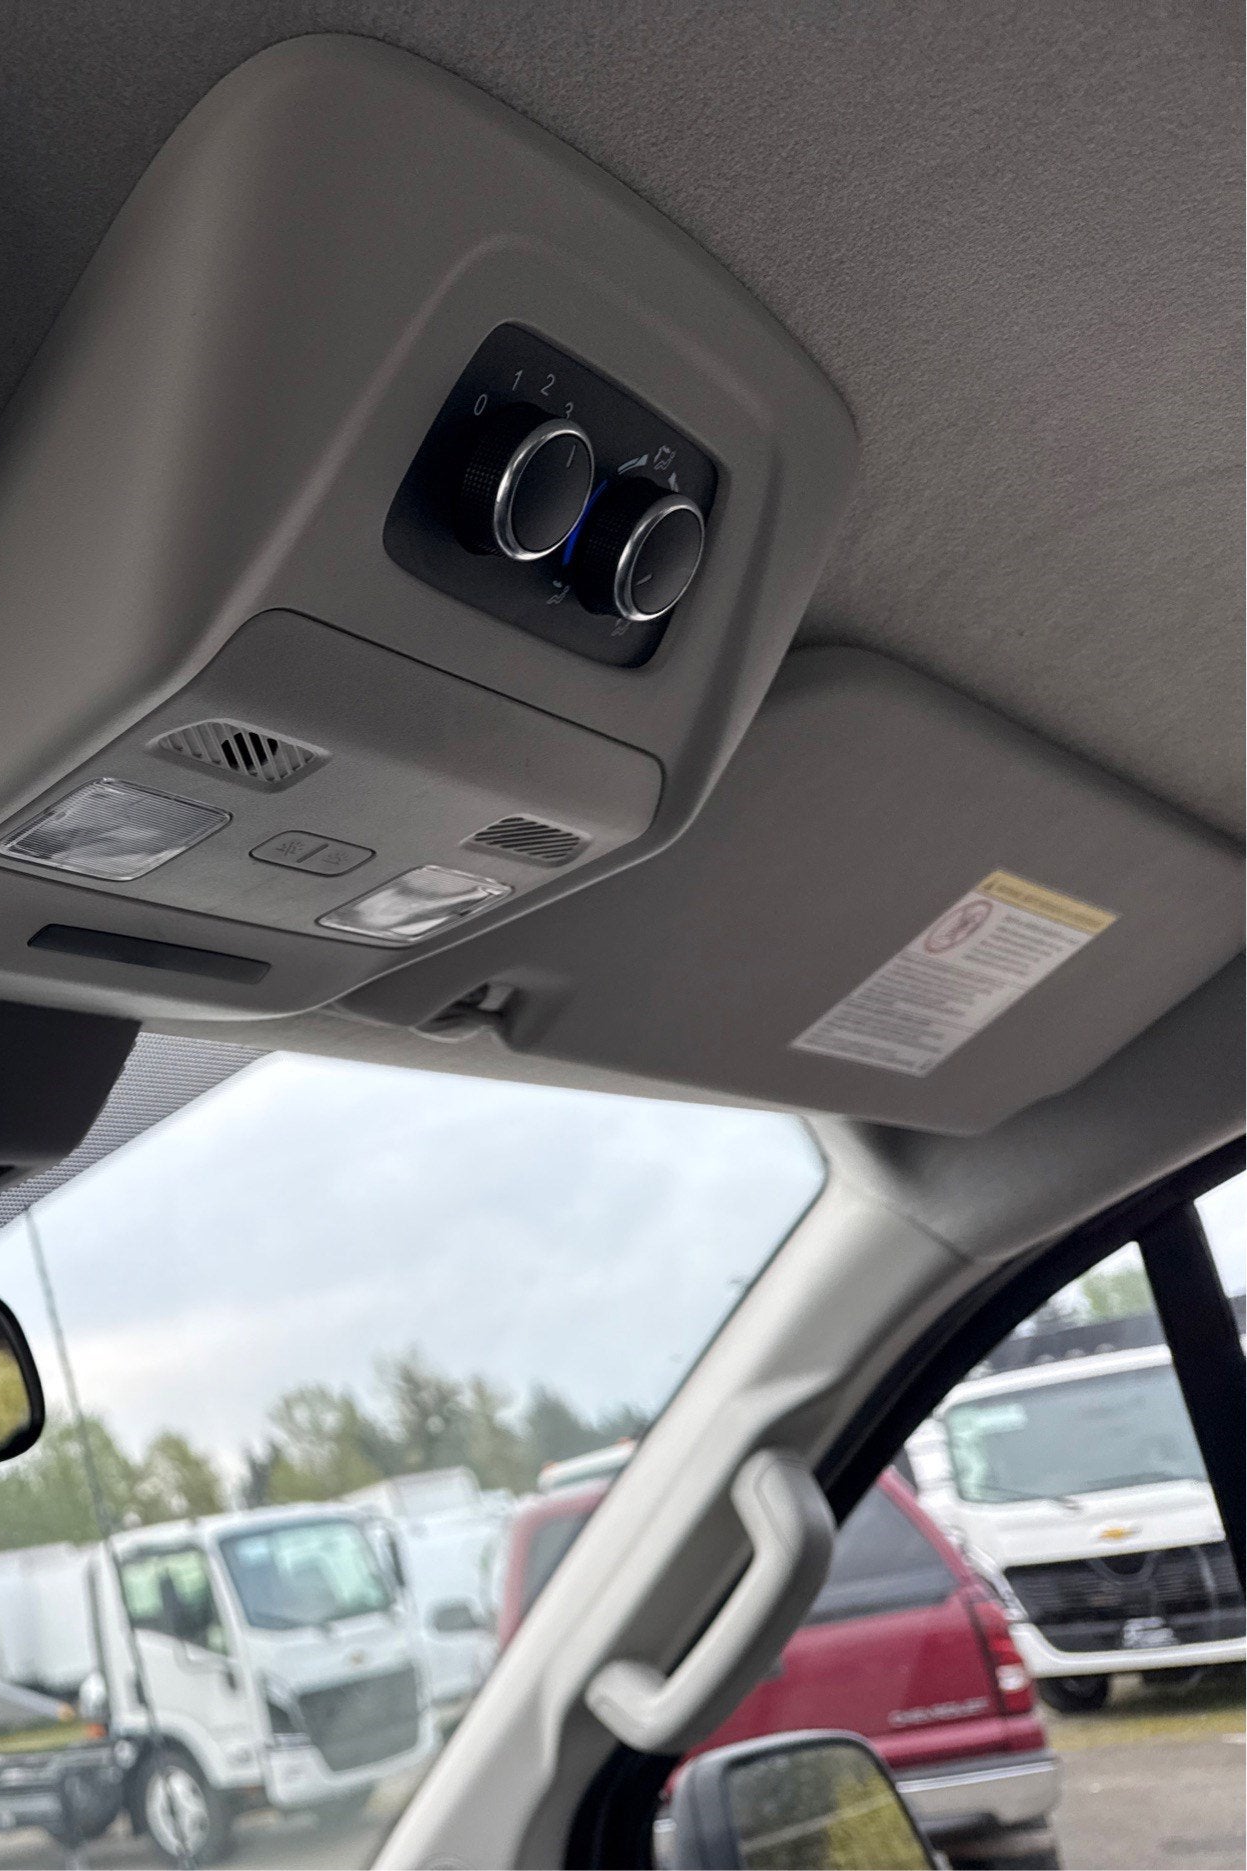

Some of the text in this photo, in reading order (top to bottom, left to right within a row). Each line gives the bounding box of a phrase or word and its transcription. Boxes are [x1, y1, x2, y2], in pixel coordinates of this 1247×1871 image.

[512, 369, 523, 391] 1
[540, 373, 555, 396] 2
[473, 393, 488, 416] 0
[564, 401, 574, 419] 3
